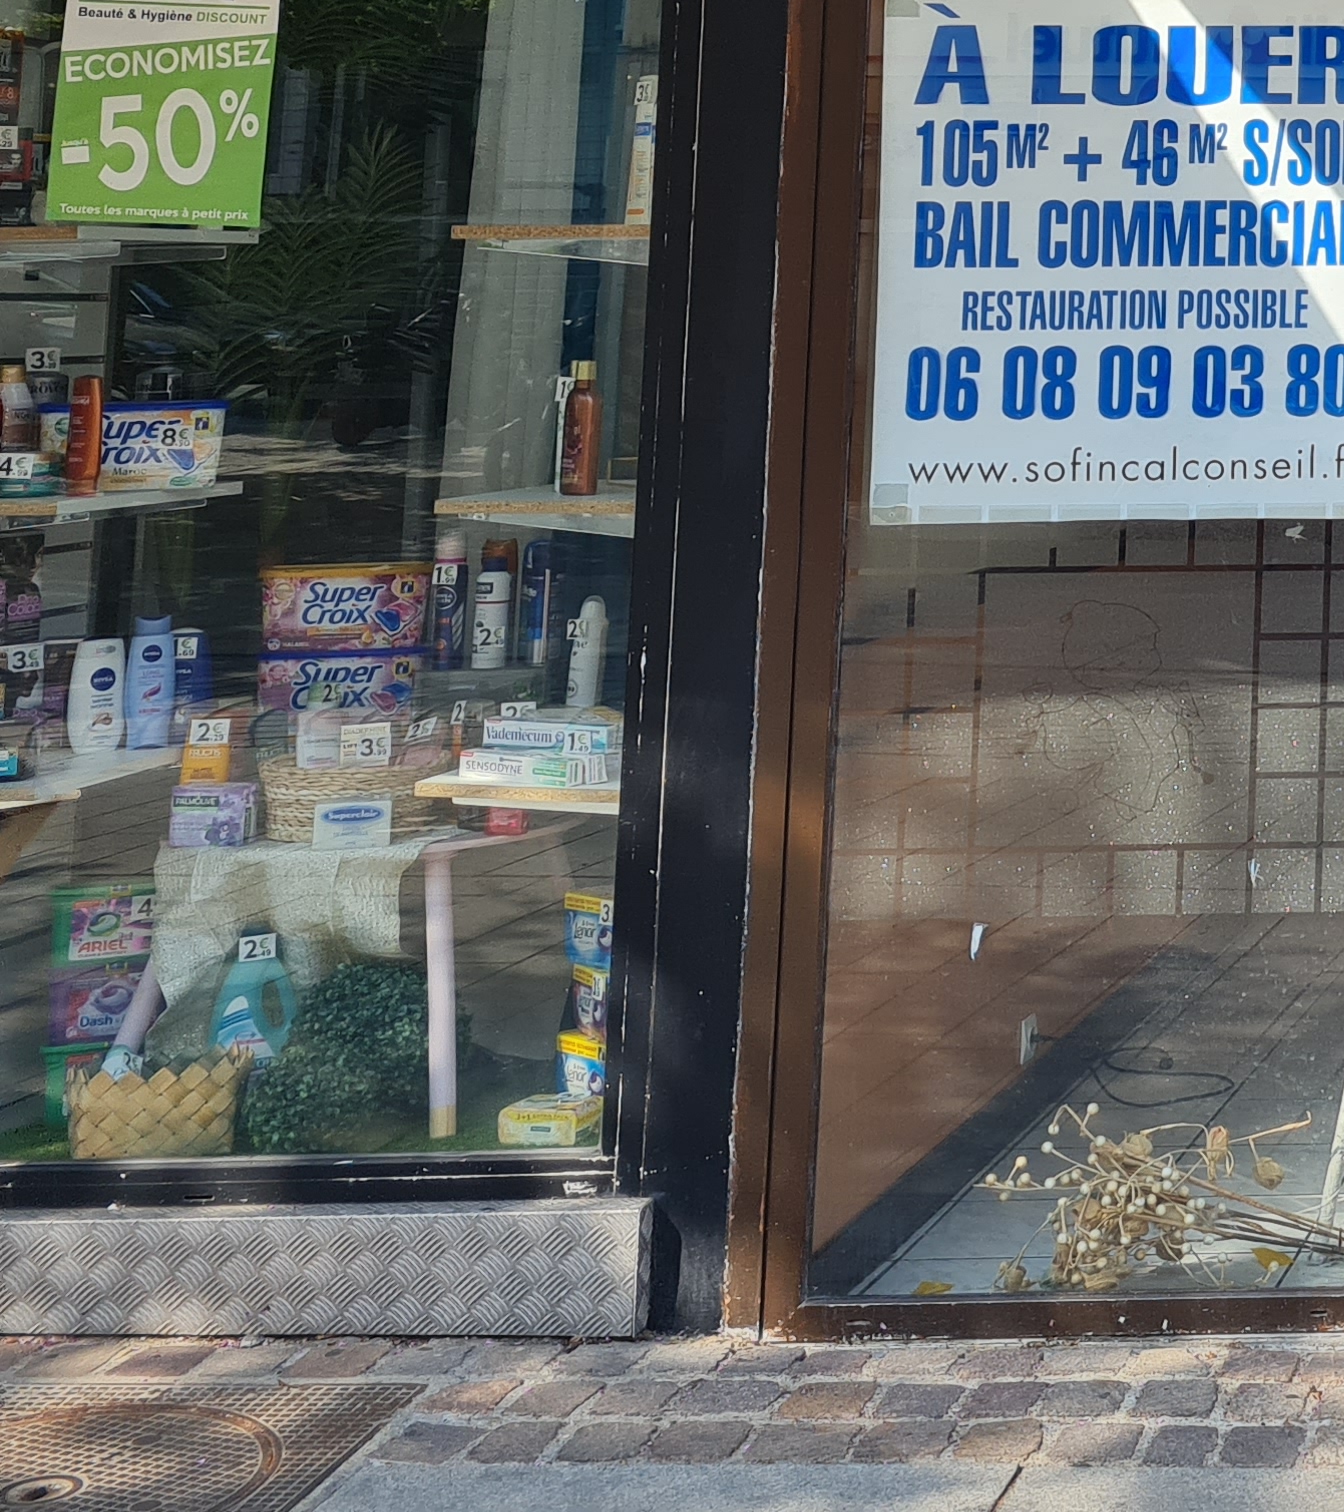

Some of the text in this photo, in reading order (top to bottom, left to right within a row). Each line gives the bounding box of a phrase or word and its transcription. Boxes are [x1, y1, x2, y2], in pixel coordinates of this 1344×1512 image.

[78, 6, 268, 25] Beauté & Hygiène DISCOUNT
[64, 38, 272, 84] ECONOMISEZ
[914, 2, 990, 105] À
[915, 119, 999, 188] 105
[1063, 135, 1102, 182] +
[1122, 119, 1179, 187] 46
[59, 202, 249, 221] Toutes les marques à petit prix
[913, 200, 1019, 269] BAIL
[960, 288, 1309, 332] RESTAURATION POSSIBLE
[905, 345, 981, 422] 06
[1000, 345, 1077, 421] 08
[1098, 344, 1173, 420] 09
[1191, 344, 1266, 418] 03
[304, 581, 386, 608] Super
[302, 603, 373, 625] Croix
[486, 725, 552, 744] Vademecum
[465, 760, 523, 775] SENSODYNE
[176, 796, 217, 807] PALMOLIVE
[326, 809, 379, 822] Superclair
[77, 939, 128, 954] ARIEL
[79, 1013, 114, 1028] Dash
